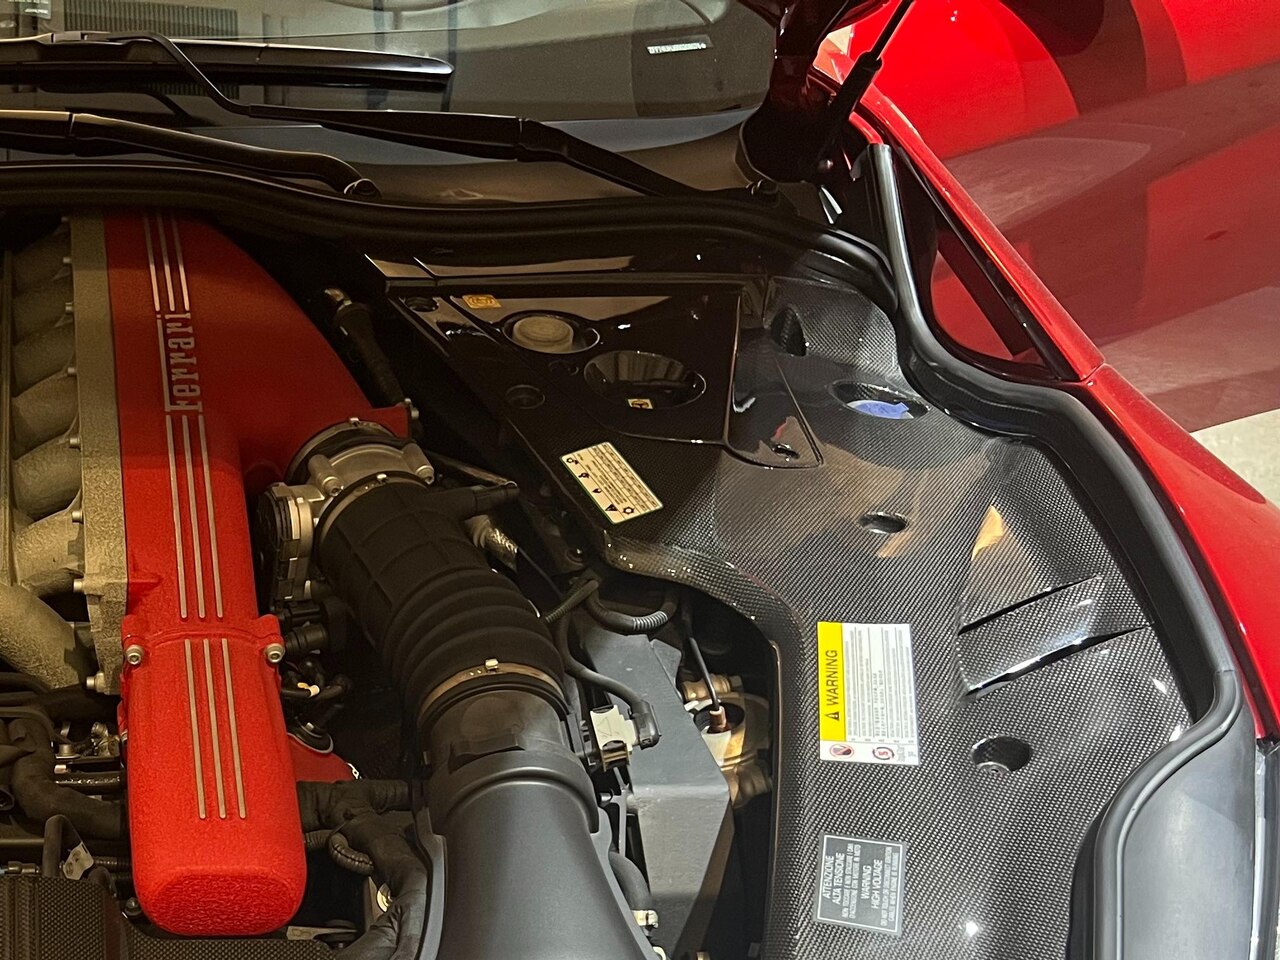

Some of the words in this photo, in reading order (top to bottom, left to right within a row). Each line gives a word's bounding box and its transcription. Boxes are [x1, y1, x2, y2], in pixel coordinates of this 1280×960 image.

[156, 312, 202, 413] Ferrari
[826, 650, 839, 706] WARNING
[824, 856, 834, 899] ATTENZIONE
[835, 852, 844, 886] TENSIONE
[861, 865, 871, 899] WARNING
[873, 859, 882, 889] VOLTAGE
[832, 888, 841, 904] ALTA
[871, 891, 880, 908] HIGH
